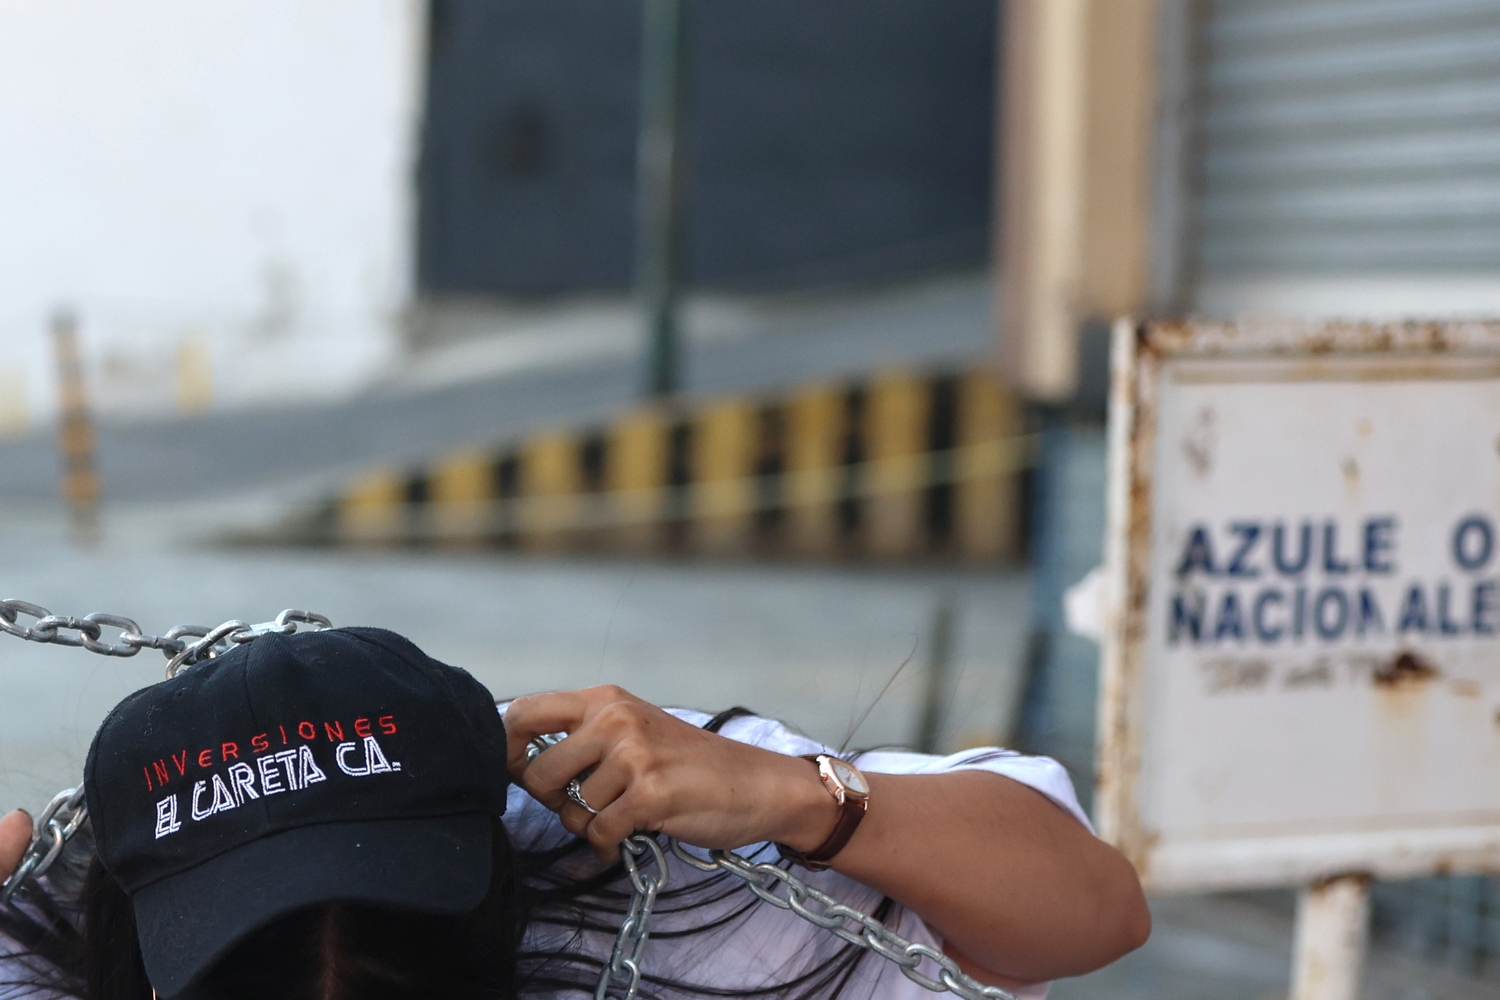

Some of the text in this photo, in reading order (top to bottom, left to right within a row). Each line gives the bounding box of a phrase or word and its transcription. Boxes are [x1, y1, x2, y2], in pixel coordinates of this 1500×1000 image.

[1175, 514, 1397, 579] AZULE
[143, 714, 398, 792] INVERSIONES
[154, 793, 182, 840] EL
[191, 744, 328, 822] CARETA
